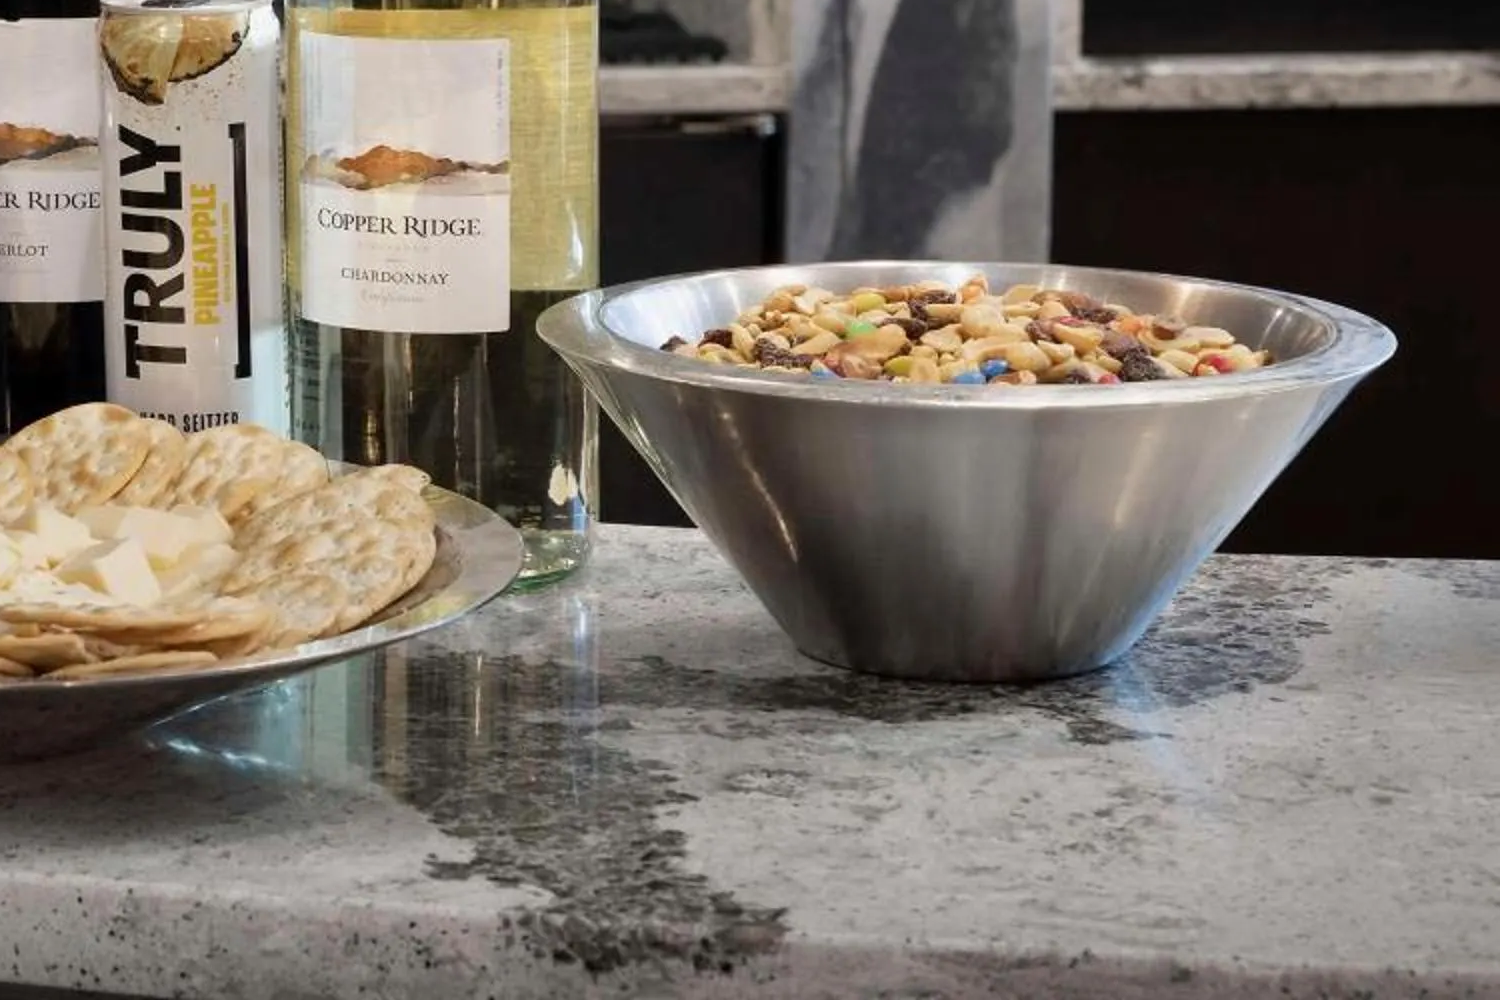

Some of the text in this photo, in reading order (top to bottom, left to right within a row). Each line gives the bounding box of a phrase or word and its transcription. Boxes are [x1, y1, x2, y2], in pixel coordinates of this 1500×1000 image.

[28, 191, 101, 212] RIDGE
[317, 207, 482, 238] COPPER RIDGE
[119, 124, 187, 379] TRULY
[190, 183, 220, 326] PINEAPPLE
[340, 266, 450, 286] CHARDONNAY
